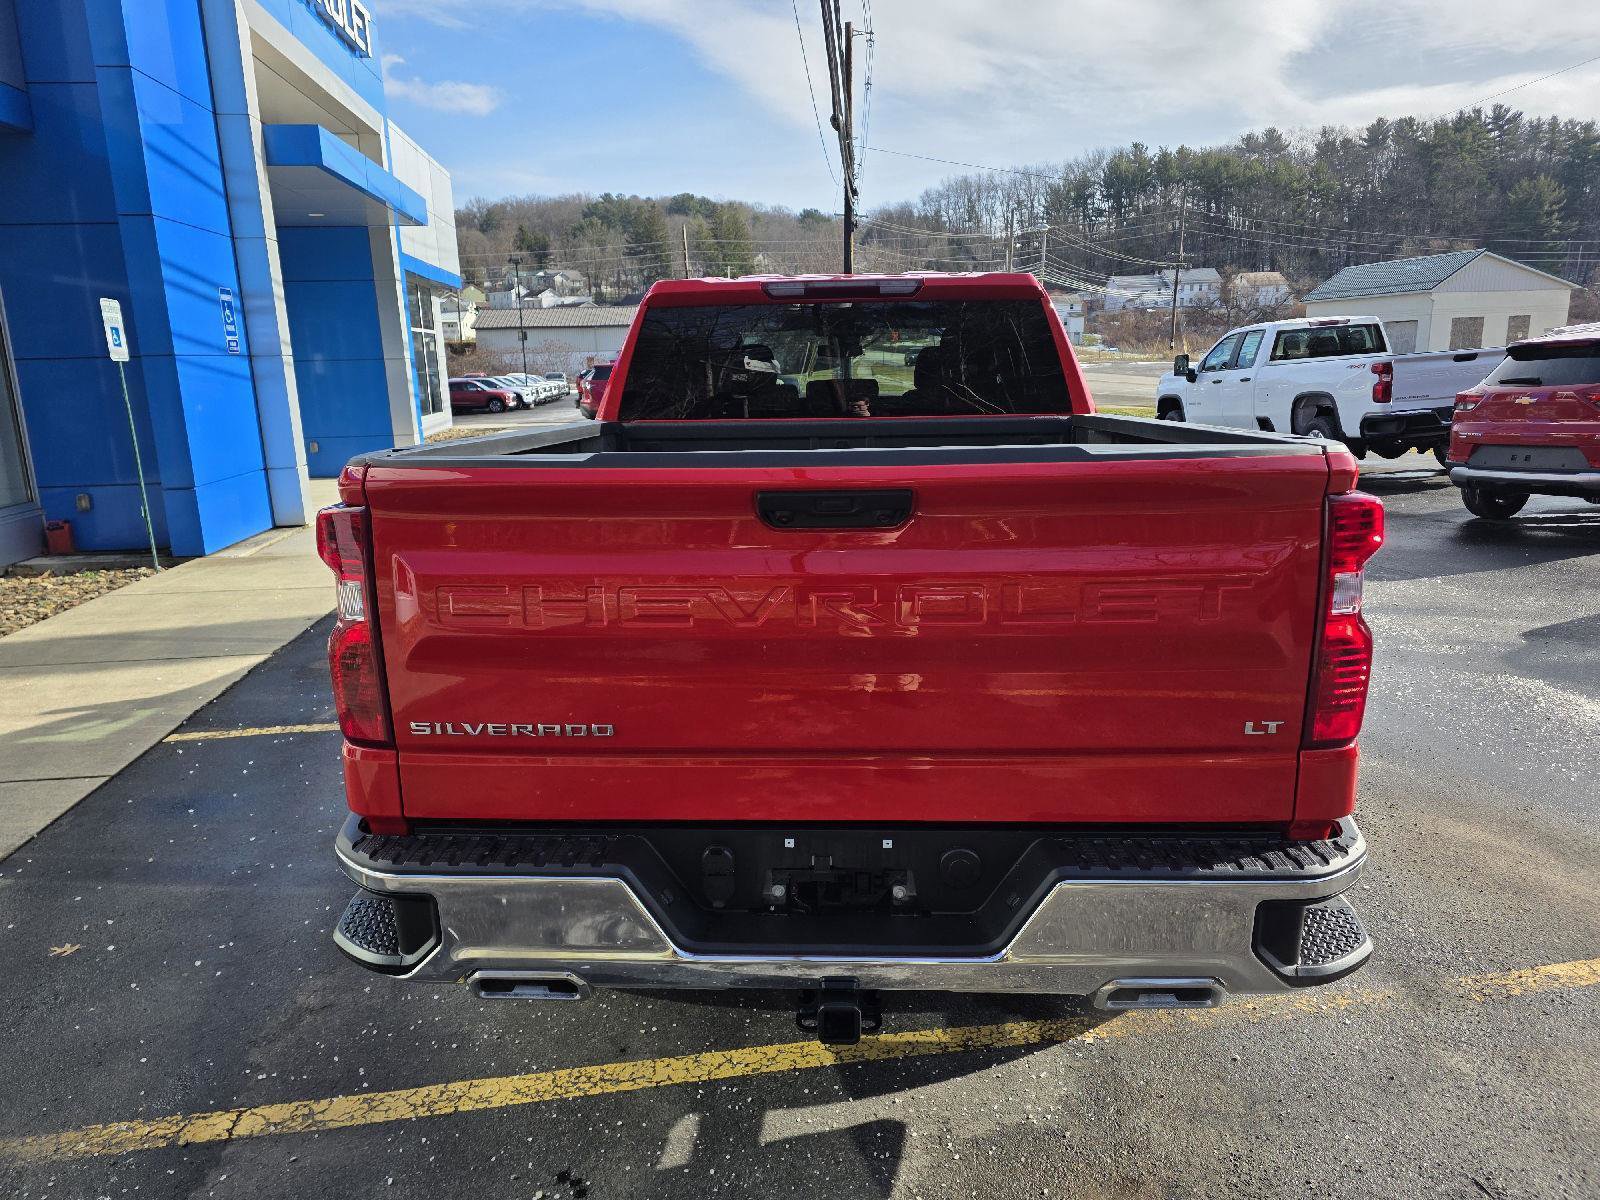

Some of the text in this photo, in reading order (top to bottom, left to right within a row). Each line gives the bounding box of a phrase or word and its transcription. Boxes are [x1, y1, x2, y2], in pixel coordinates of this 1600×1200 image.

[435, 578, 1255, 626] CHEVROLET
[409, 721, 615, 737] SILVERADO
[1244, 720, 1285, 735] LT
